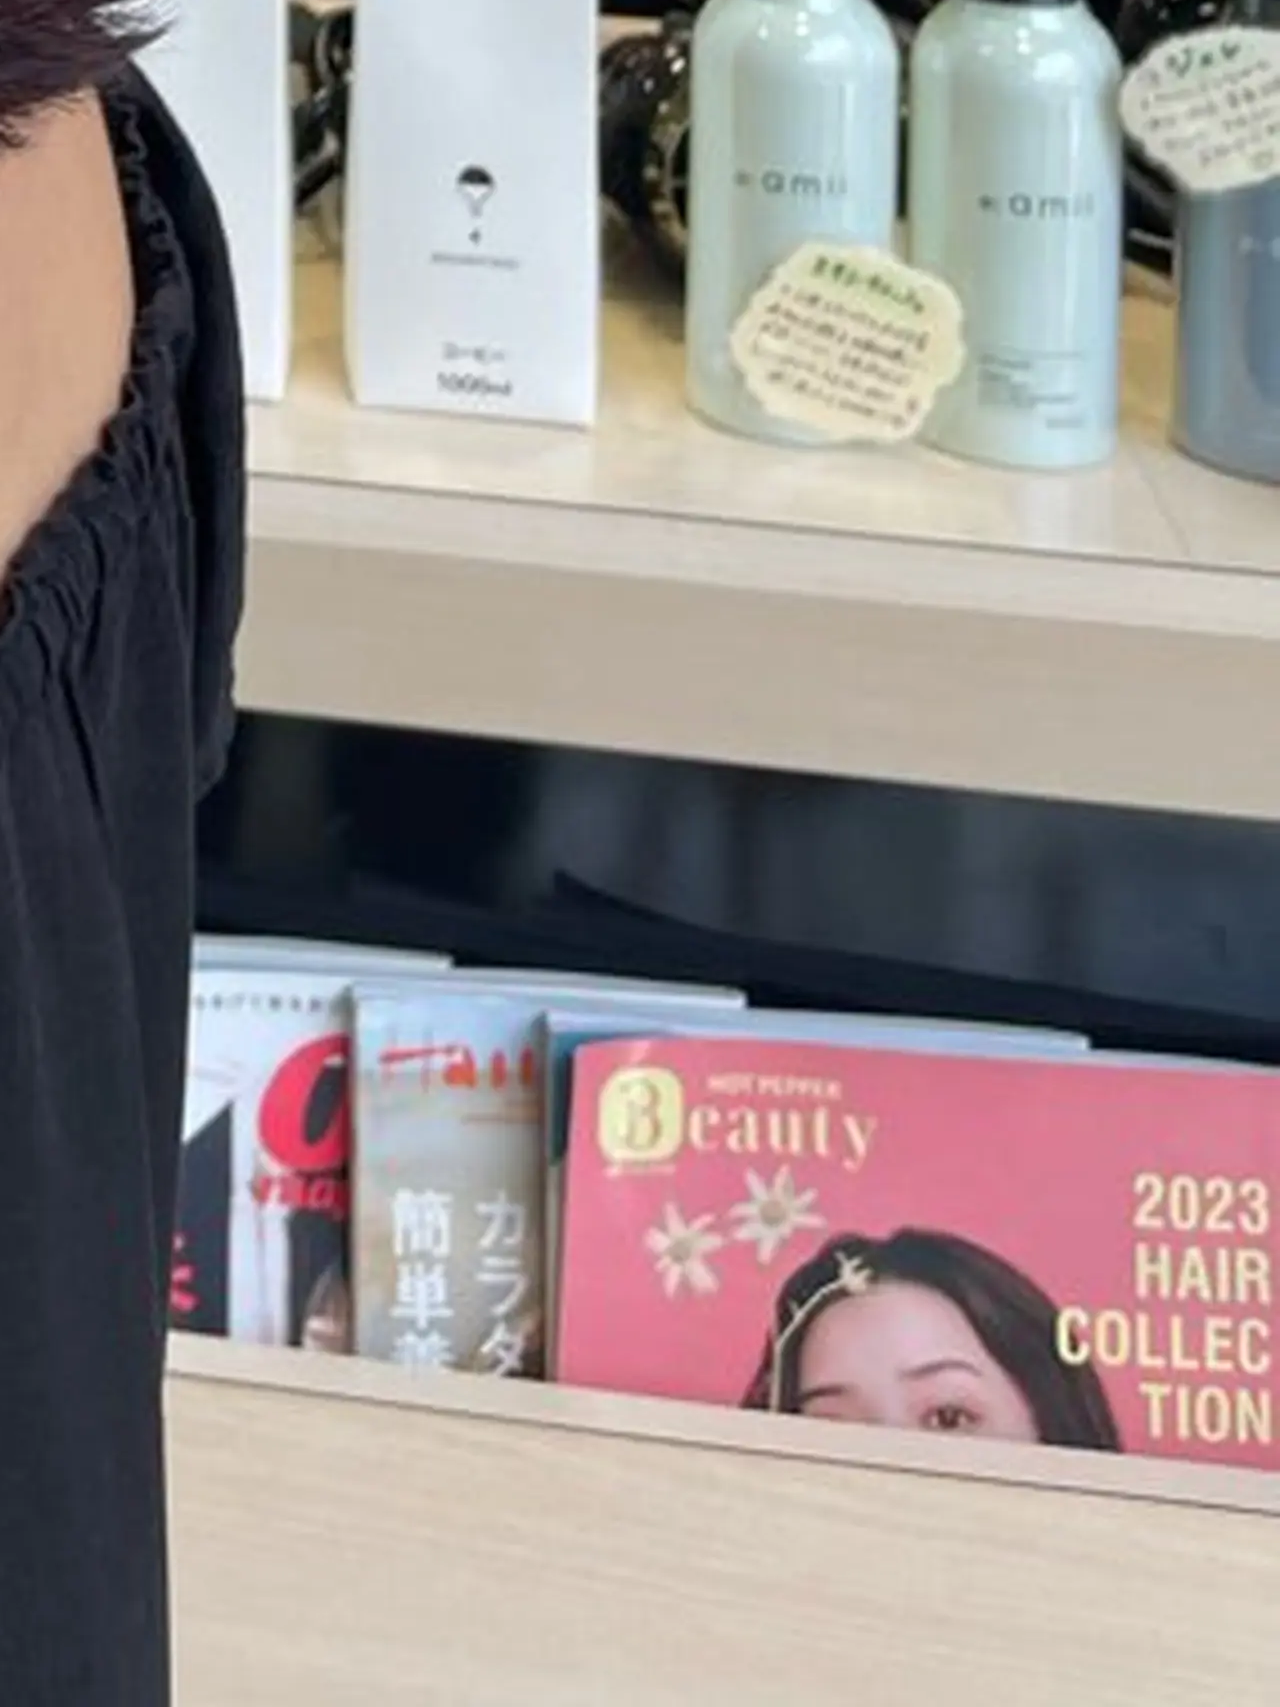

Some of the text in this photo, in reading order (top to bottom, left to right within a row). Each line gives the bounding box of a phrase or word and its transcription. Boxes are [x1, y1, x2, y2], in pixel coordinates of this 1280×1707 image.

[603, 1068, 878, 1174] Beauty
[1132, 1171, 1269, 1235] 2023
[1134, 1240, 1270, 1306] HAIR
[1056, 1304, 1271, 1375] COLLEC
[1138, 1380, 1272, 1445] TION
